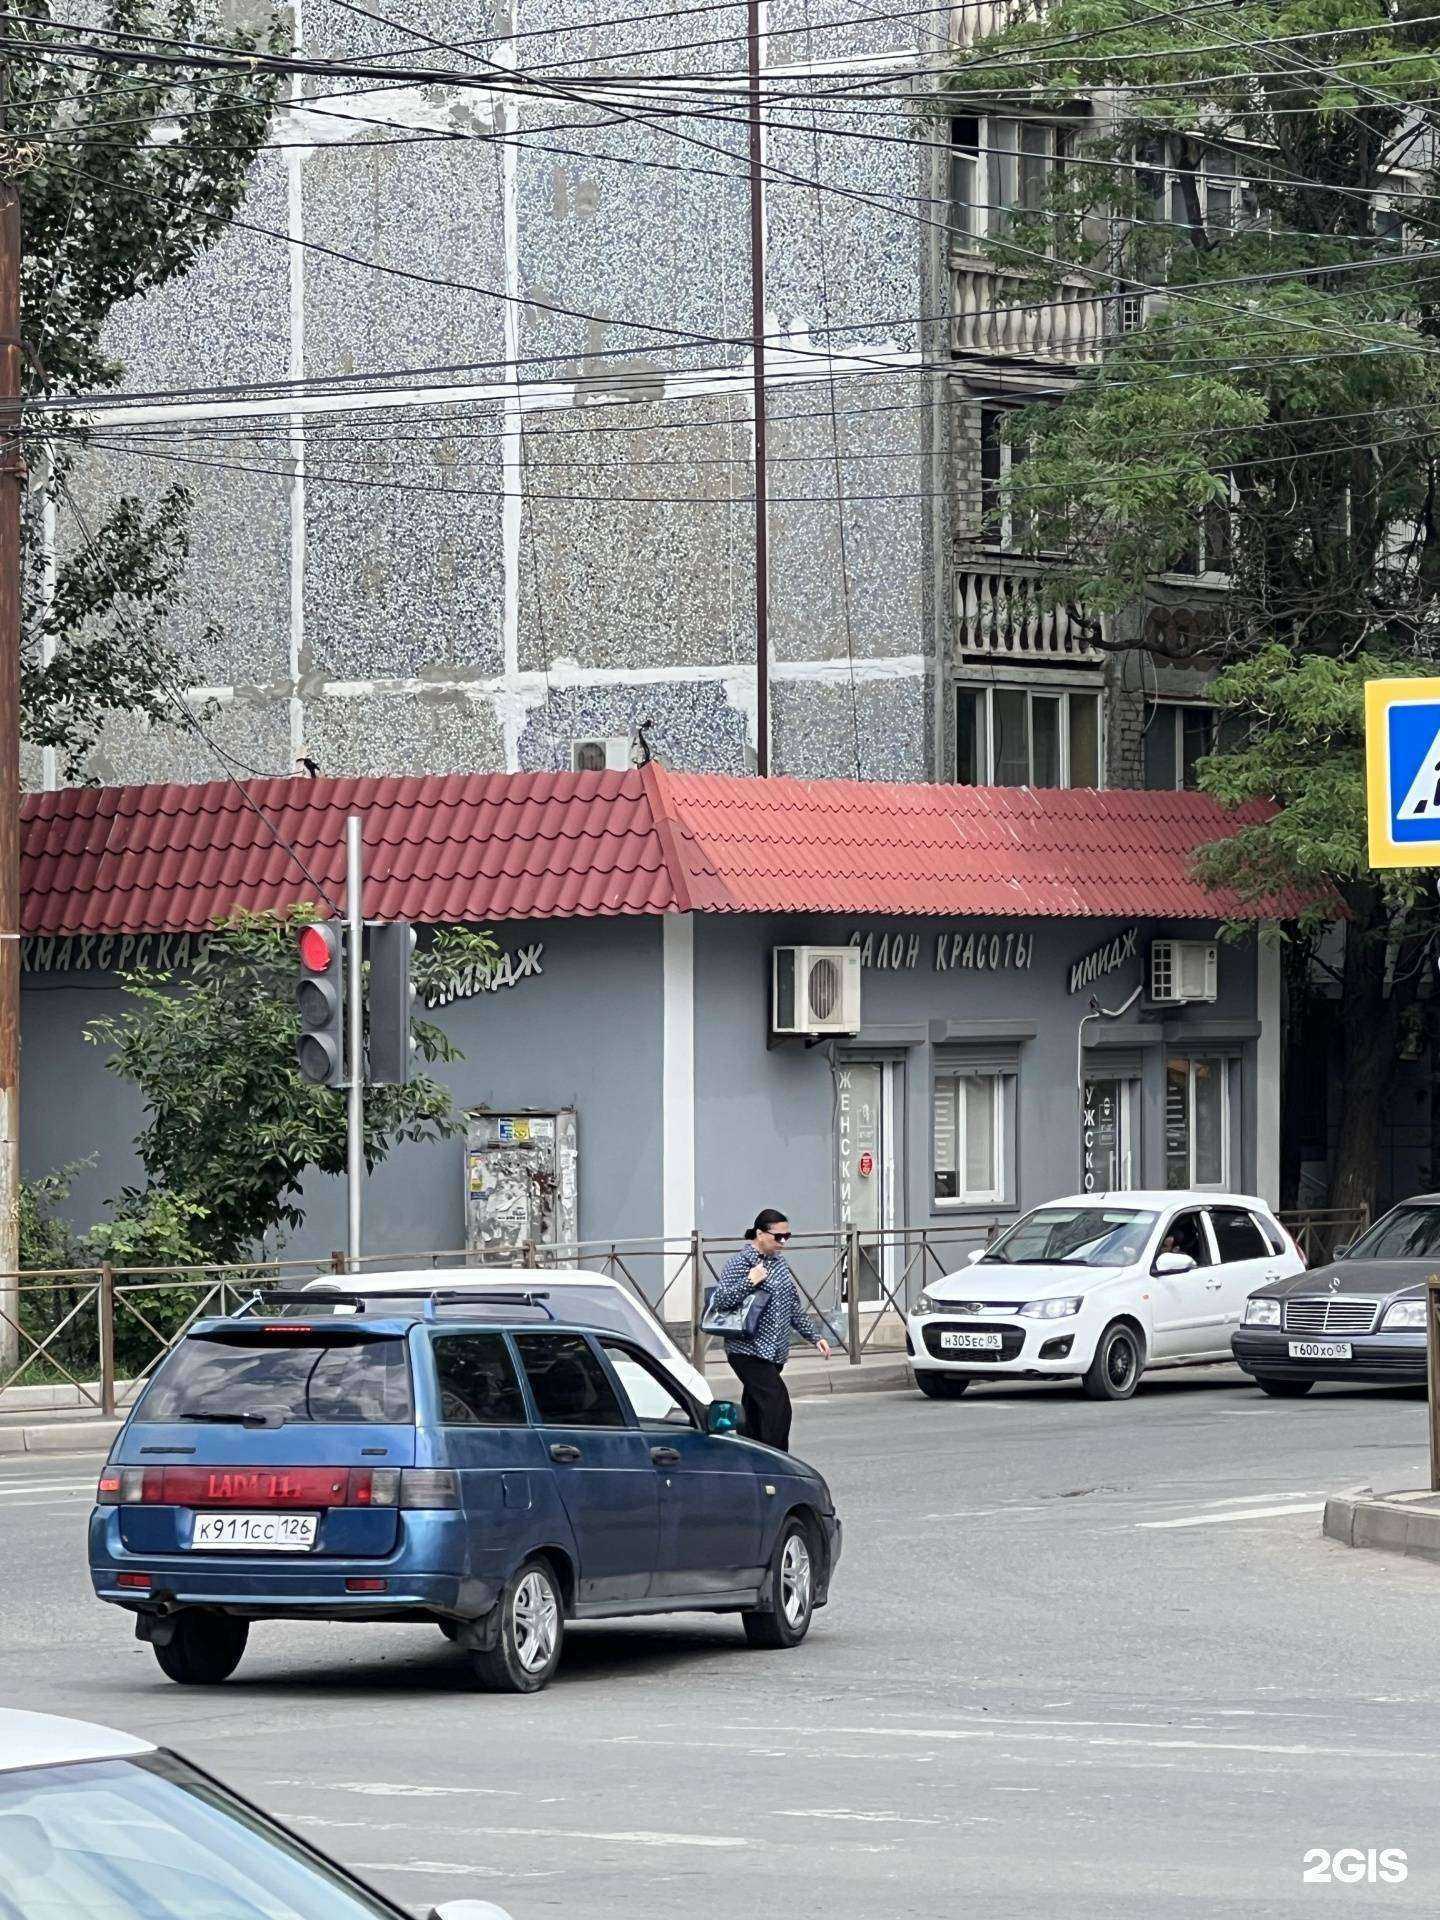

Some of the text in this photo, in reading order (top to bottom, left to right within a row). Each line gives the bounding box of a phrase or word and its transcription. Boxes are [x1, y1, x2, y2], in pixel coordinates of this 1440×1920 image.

[936, 934, 1033, 970] КРАСОТЫ
[1071, 928, 1138, 993] ИМИДЖ
[1084, 1086, 1095, 1192] УЖСКО
[200, 1519, 312, 1539] К911СС 126
